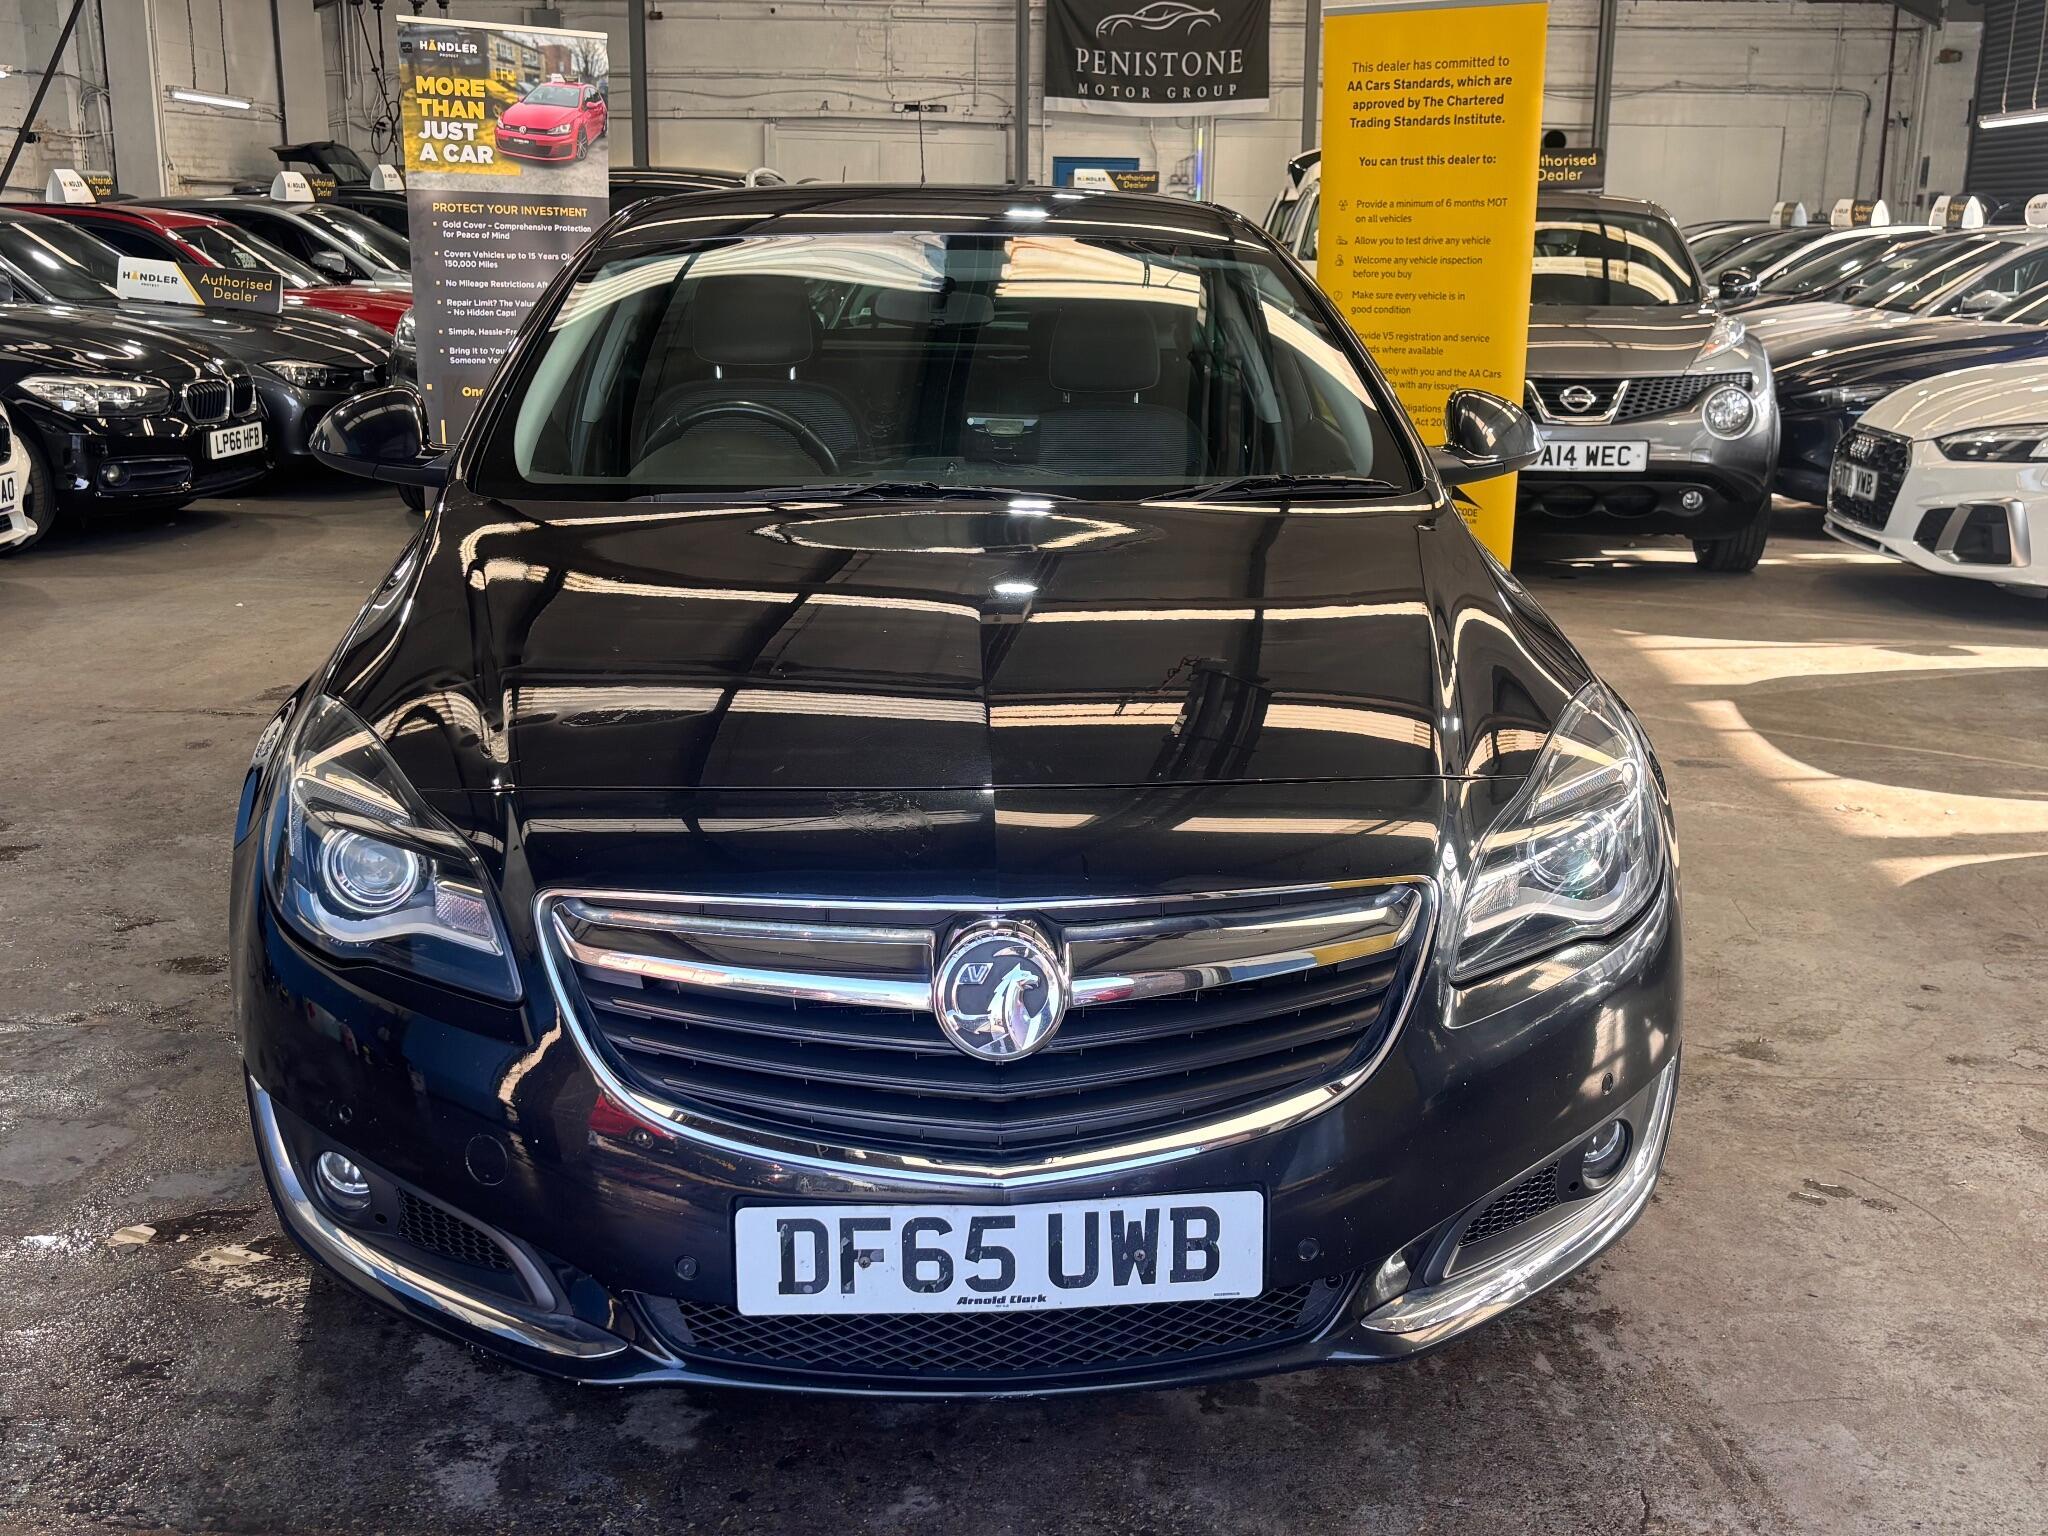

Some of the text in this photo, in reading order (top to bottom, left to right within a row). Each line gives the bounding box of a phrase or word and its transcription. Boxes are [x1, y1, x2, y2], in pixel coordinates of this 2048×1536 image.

[1075, 48, 1243, 77] PENISTONE
[1352, 56, 1510, 73] This dealer has committed to
[415, 75, 486, 98] MORE
[1347, 75, 1512, 92] AA Cars Standards, which are
[1077, 83, 1238, 99] MOTOR GROUP
[416, 97, 485, 120] THAN
[1352, 94, 1505, 112] approved by The Chartered
[1350, 113, 1505, 130] Trading Standards Institute.
[418, 120, 479, 141] JUST
[419, 142, 494, 164] A CAR
[1359, 153, 1497, 167] You can trust this dealer to:
[1541, 153, 1597, 167] thorised
[1537, 167, 1583, 181] Dealer
[1356, 199, 1388, 209] Provide
[1396, 200, 1434, 208] minimum
[1435, 199, 1444, 208] of
[1446, 198, 1452, 208] 6
[1454, 198, 1486, 208] months
[1487, 197, 1508, 208] MOT
[432, 202, 588, 218] PROTECT YOUR INVESTMENT
[1368, 214, 1378, 222] all
[1380, 214, 1412, 222] vehicles
[442, 220, 462, 229] Gold
[463, 221, 486, 230] Cover
[494, 222, 552, 232] Comprehensive
[554, 224, 592, 233] Protection
[442, 230, 454, 238] for
[456, 230, 480, 239] Peace
[491, 232, 510, 240] Mind
[1354, 236, 1492, 247] Allow you to test drive any vehicle
[444, 250, 472, 258] Covers
[473, 251, 505, 259] Vehicles
[506, 252, 516, 260] up
[538, 252, 560, 260] Years
[1354, 256, 1483, 266] Welcome any vehicle inspection
[444, 260, 477, 269] 150,000
[1352, 270, 1412, 280] before you buy
[200, 272, 273, 292] Authorised
[458, 280, 488, 290] Mileage
[490, 281, 535, 289] Restrictions
[536, 281, 549, 289] Aft
[213, 286, 258, 302] Dealer
[1352, 291, 1374, 300] Make
[1394, 292, 1417, 302] every
[1418, 292, 1448, 300] vehicle
[1448, 291, 1456, 300] is
[1458, 292, 1466, 300] in
[446, 299, 472, 308] Repair
[474, 300, 498, 308] Limit?
[500, 300, 514, 308] The
[466, 308, 494, 316] Hidden
[496, 309, 517, 318] Caps!
[1350, 306, 1412, 315] good condition
[448, 328, 477, 336] Simple,
[1359, 332, 1490, 343] ovide V5 registration and service
[449, 346, 470, 356] Bring
[480, 347, 488, 355] to
[490, 348, 506, 356] You
[1382, 346, 1406, 354] where
[1408, 346, 1444, 356] available
[1382, 367, 1502, 379] sely with you and the AA Cars
[1398, 380, 1416, 389] with
[1418, 383, 1433, 392] any
[1414, 418, 1446, 428] Act 201
[214, 426, 260, 454] LP66 HFB
[1532, 446, 1632, 466] A14 WEC
[776, 1205, 1221, 1296] DF65 UWB
[956, 1294, 1047, 1305] Arnold Clark
